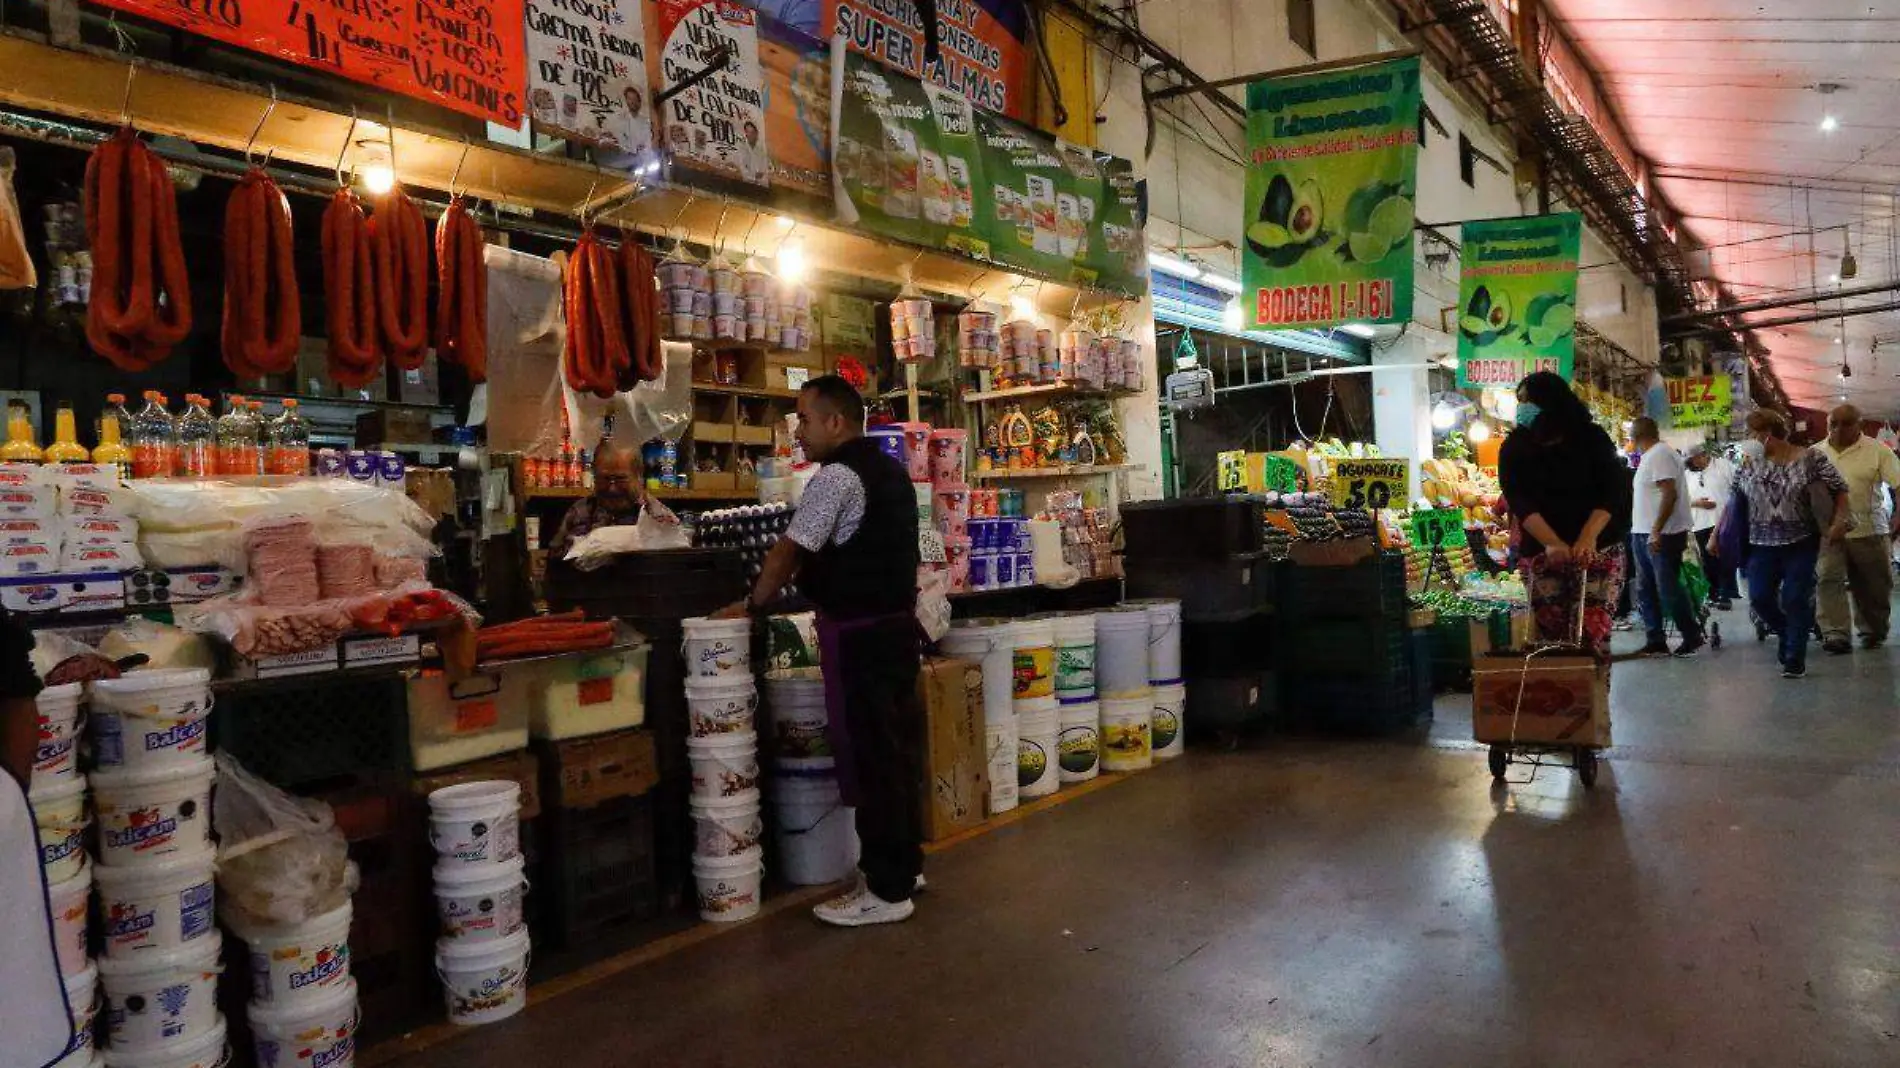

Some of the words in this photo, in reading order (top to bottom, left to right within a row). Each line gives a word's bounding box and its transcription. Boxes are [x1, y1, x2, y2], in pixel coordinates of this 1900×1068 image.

[526, 4, 595, 48] CREMA
[699, 6, 719, 30] DE
[966, 5, 978, 28] Y
[836, 5, 914, 71] SUPER
[442, 37, 486, 76] LOS
[572, 44, 618, 78] LALA
[539, 60, 566, 85] DE
[673, 99, 697, 124] DE
[698, 89, 742, 119] LALA
[1257, 284, 1333, 325] BODEGA
[1666, 376, 1718, 404] UEZ
[1344, 479, 1390, 510] 50
